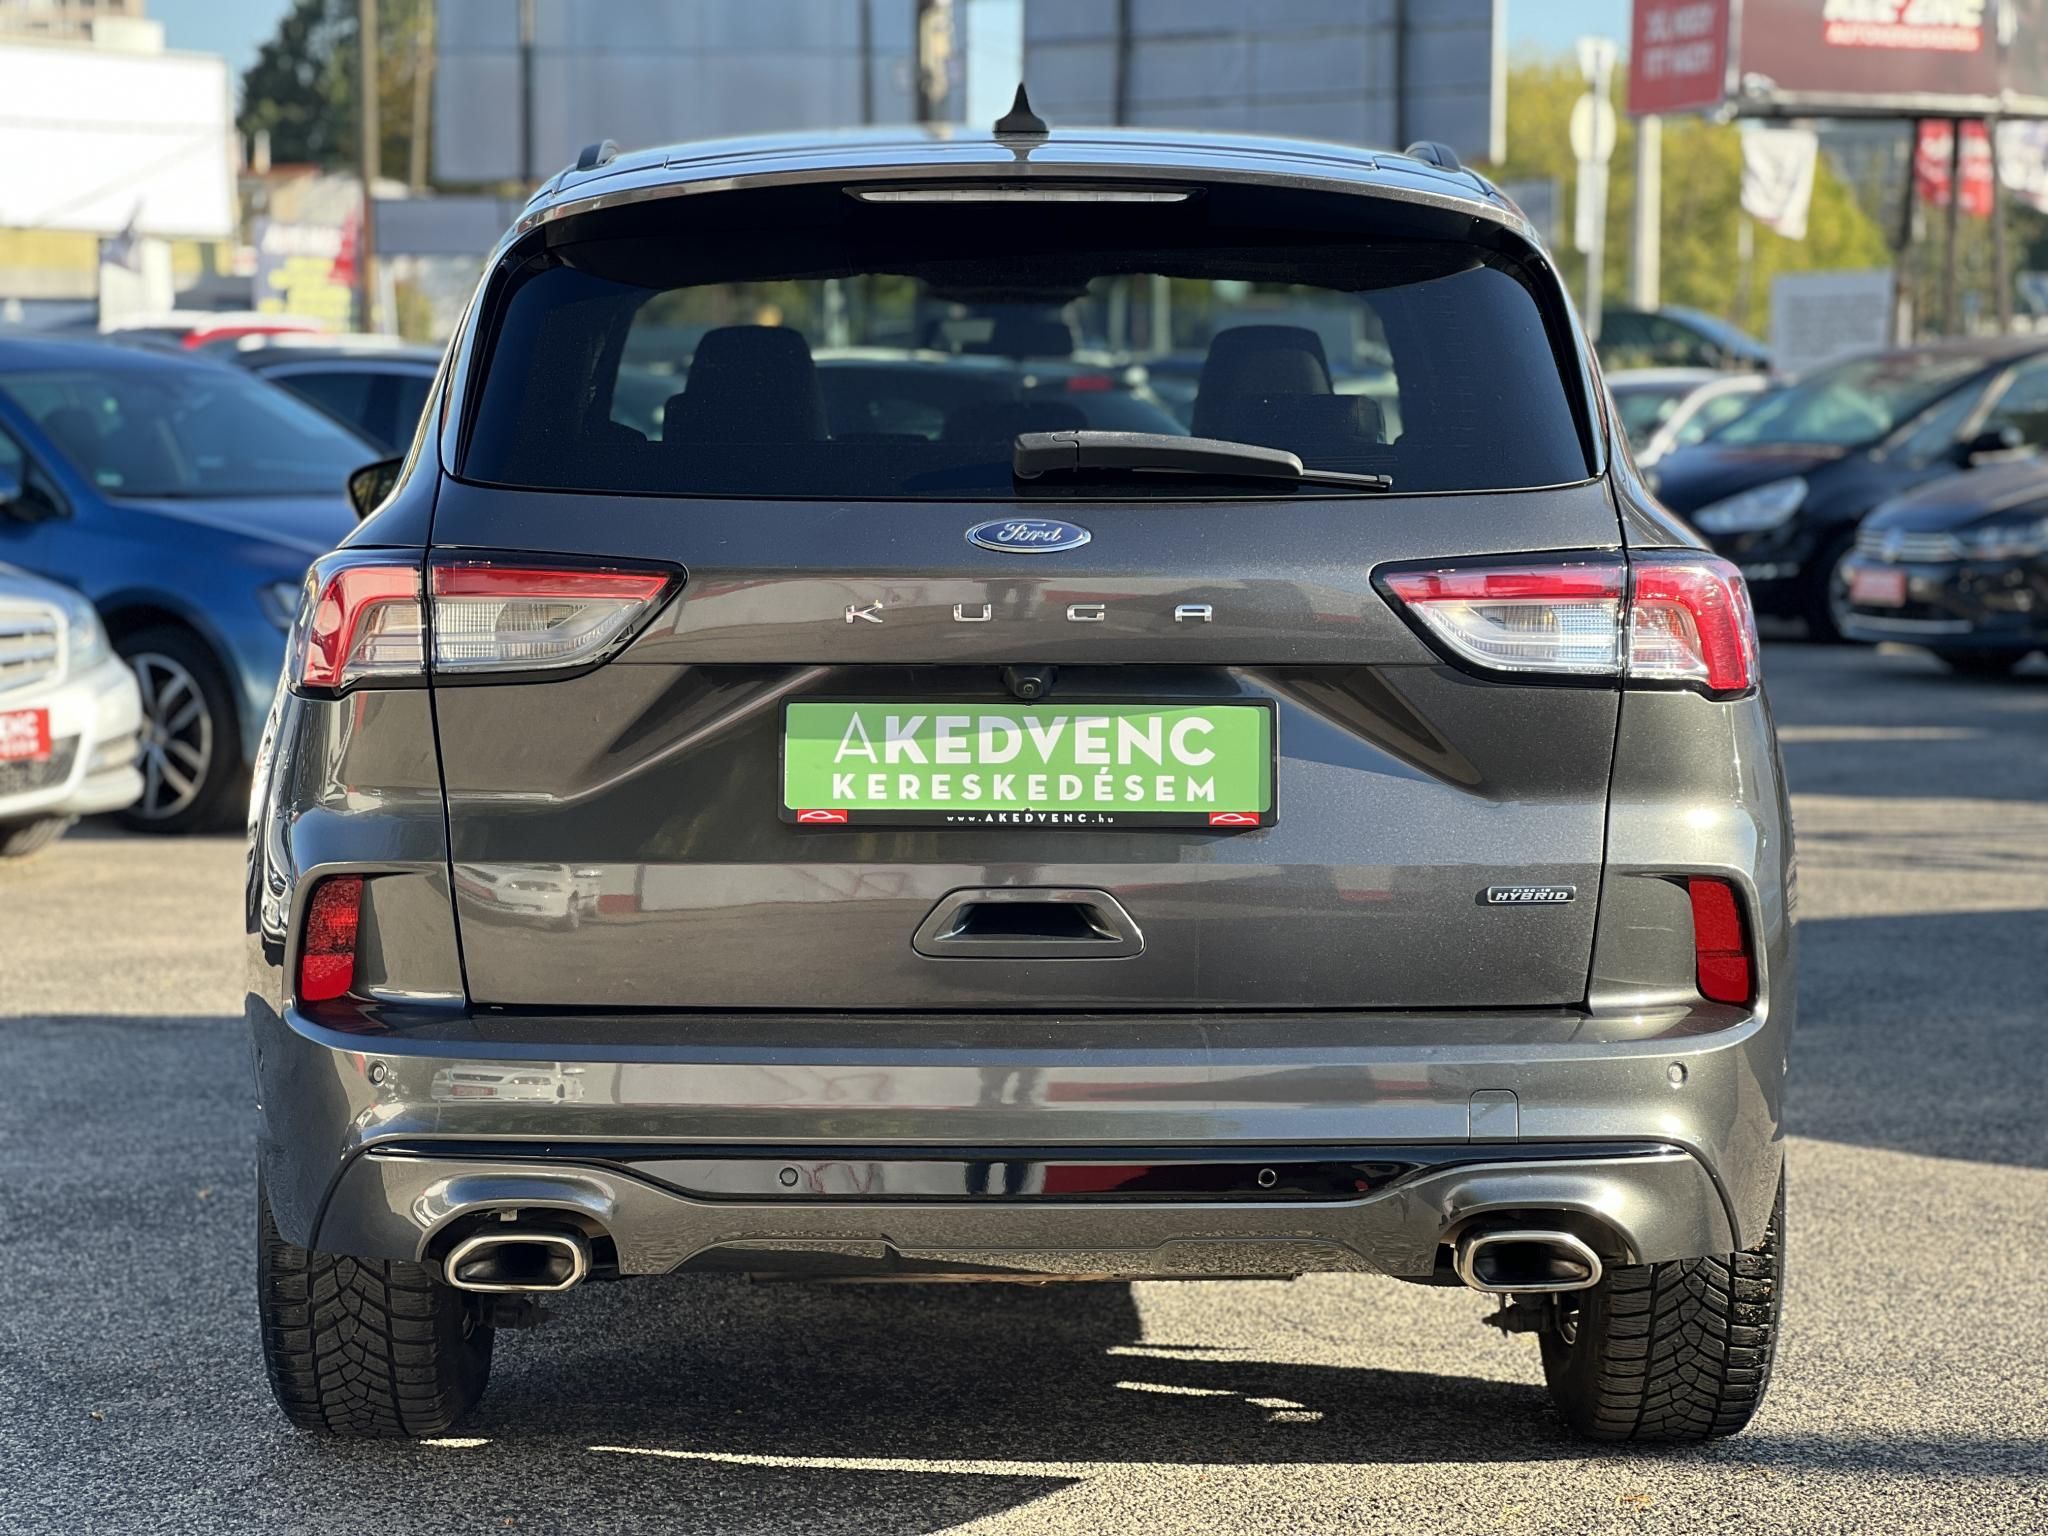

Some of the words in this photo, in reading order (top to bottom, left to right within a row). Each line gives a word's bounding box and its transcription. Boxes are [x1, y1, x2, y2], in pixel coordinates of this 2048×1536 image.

[996, 523, 1063, 542] Ford
[845, 600, 1213, 624] KUGA
[832, 767, 1216, 802] KERESKEDÉSEM
[946, 813, 1114, 823] www.AKEDVENC.hu
[1495, 892, 1569, 901] HYBRID
